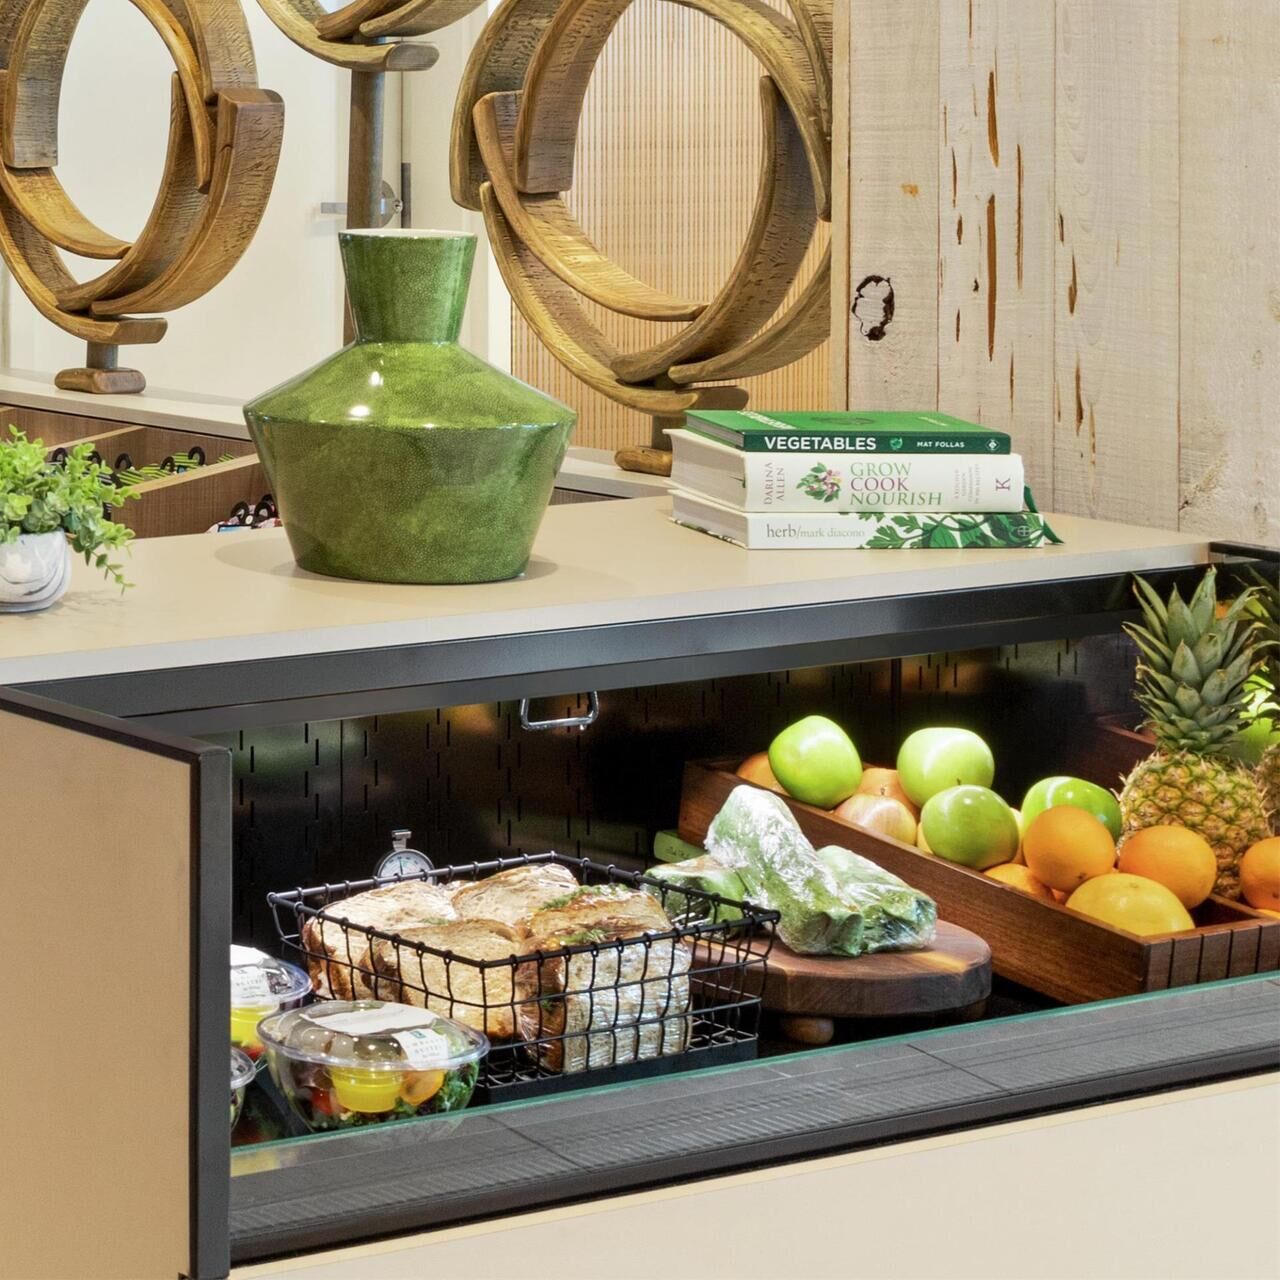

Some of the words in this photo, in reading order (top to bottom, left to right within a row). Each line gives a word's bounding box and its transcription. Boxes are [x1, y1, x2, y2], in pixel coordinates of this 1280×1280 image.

[764, 436, 877, 451] VEGETABLES
[850, 461, 912, 476] GROW
[763, 461, 773, 505] DARINA
[775, 466, 785, 501] ALLEN
[850, 477, 909, 491] COOK
[850, 492, 942, 506] NOURISH
